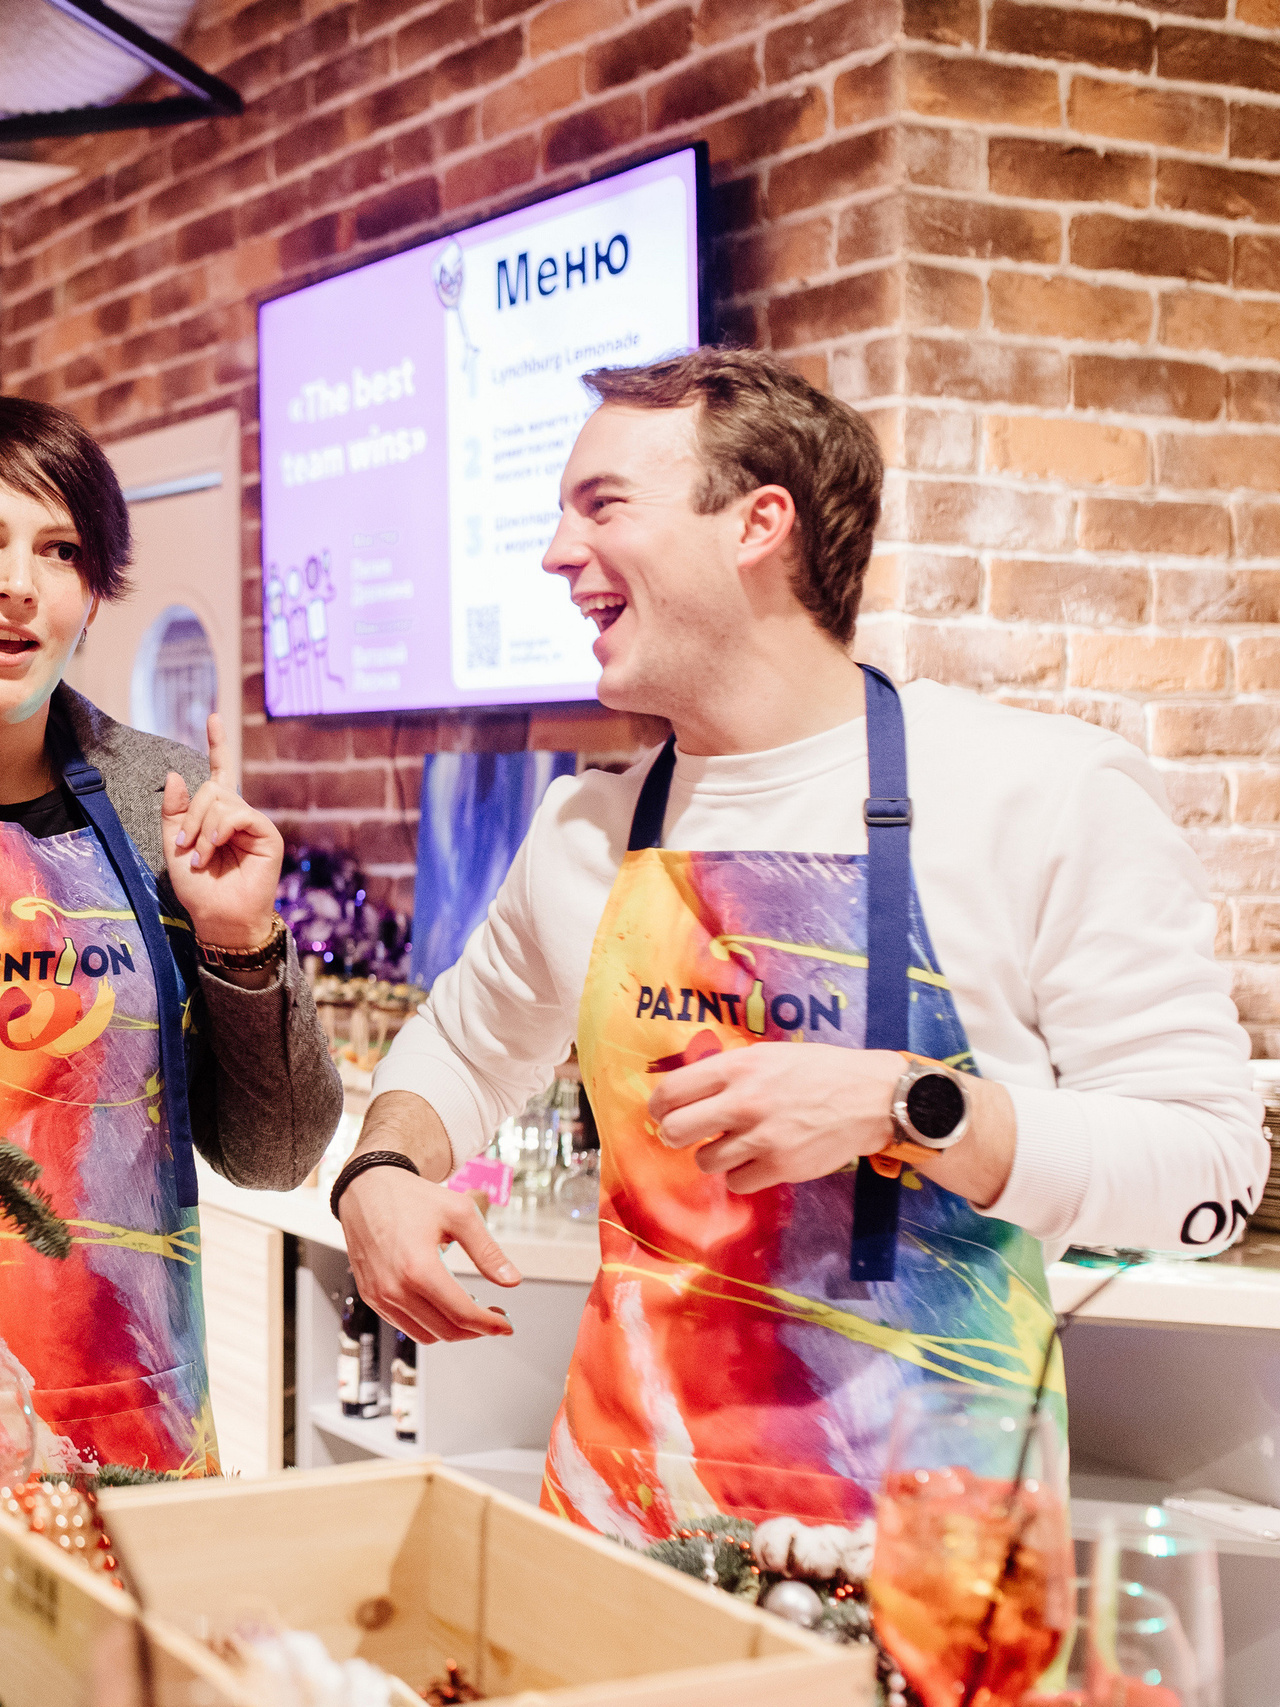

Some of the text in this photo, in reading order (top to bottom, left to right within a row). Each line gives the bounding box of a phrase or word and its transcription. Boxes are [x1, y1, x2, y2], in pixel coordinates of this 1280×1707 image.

[497, 234, 629, 310] Меню
[353, 358, 415, 408] best
[492, 332, 640, 386] Lynchburg Lemonade
[281, 446, 344, 487] team
